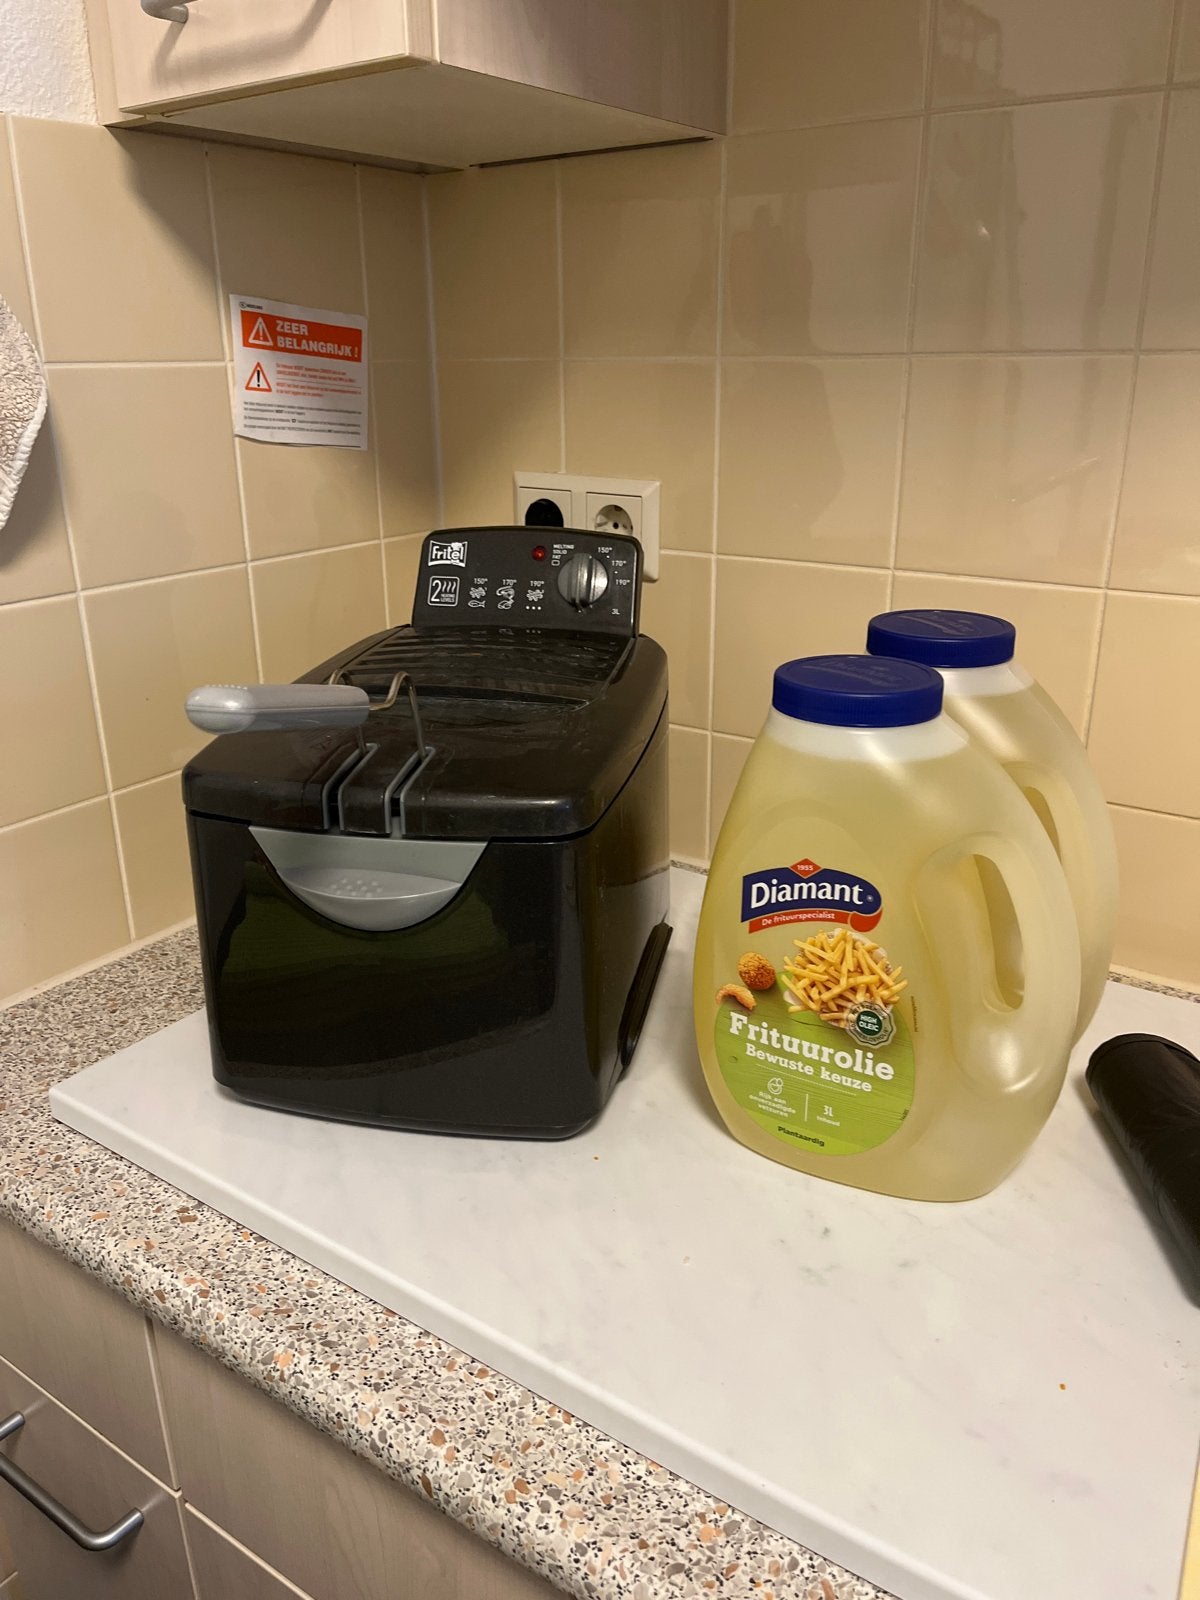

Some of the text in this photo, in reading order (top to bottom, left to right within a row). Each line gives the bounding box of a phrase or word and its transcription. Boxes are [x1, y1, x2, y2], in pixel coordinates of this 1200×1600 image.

[276, 320, 309, 336] ZEER
[276, 335, 352, 357] BELANGRIJK
[431, 580, 441, 602] 2
[750, 878, 863, 909] Diamant
[761, 910, 835, 926] De frituurspecialist
[858, 1021, 880, 1032] OLEIC
[860, 1015, 877, 1025] HIGH
[729, 1011, 895, 1081] Frituurolie
[745, 1042, 872, 1092] Bewuste keuze
[823, 1104, 833, 1117] 3L
[777, 1125, 825, 1147] Plantaardig
